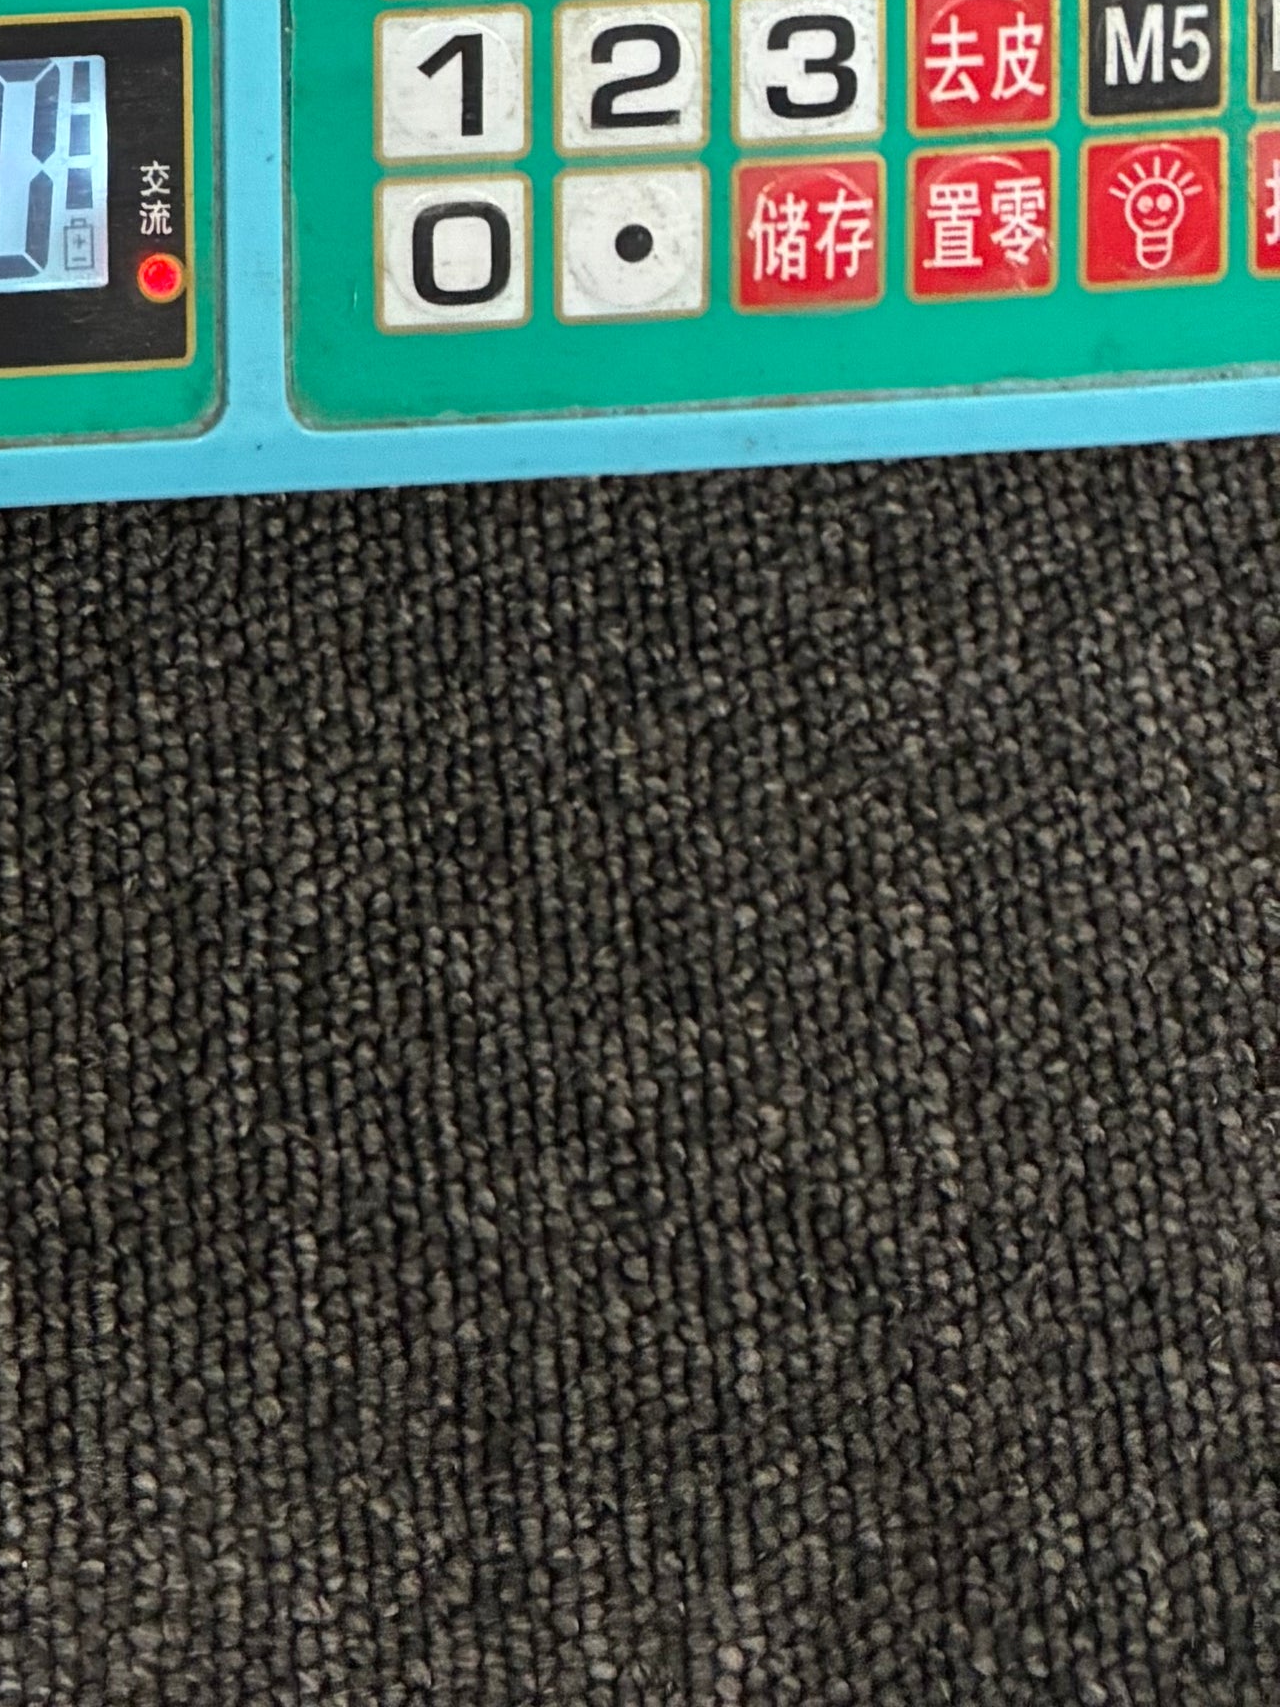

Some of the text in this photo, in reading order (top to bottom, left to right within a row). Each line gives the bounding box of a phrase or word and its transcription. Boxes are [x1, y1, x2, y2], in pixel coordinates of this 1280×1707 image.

[415, 31, 486, 137] 1
[589, 23, 683, 129] 2
[765, 14, 858, 119] 3
[923, 11, 1045, 104] 去皮
[1104, 4, 1213, 86] M5
[137, 160, 174, 238] 交流
[747, 190, 875, 284] 储存
[922, 178, 1048, 272] 置零
[410, 201, 512, 307] 0
